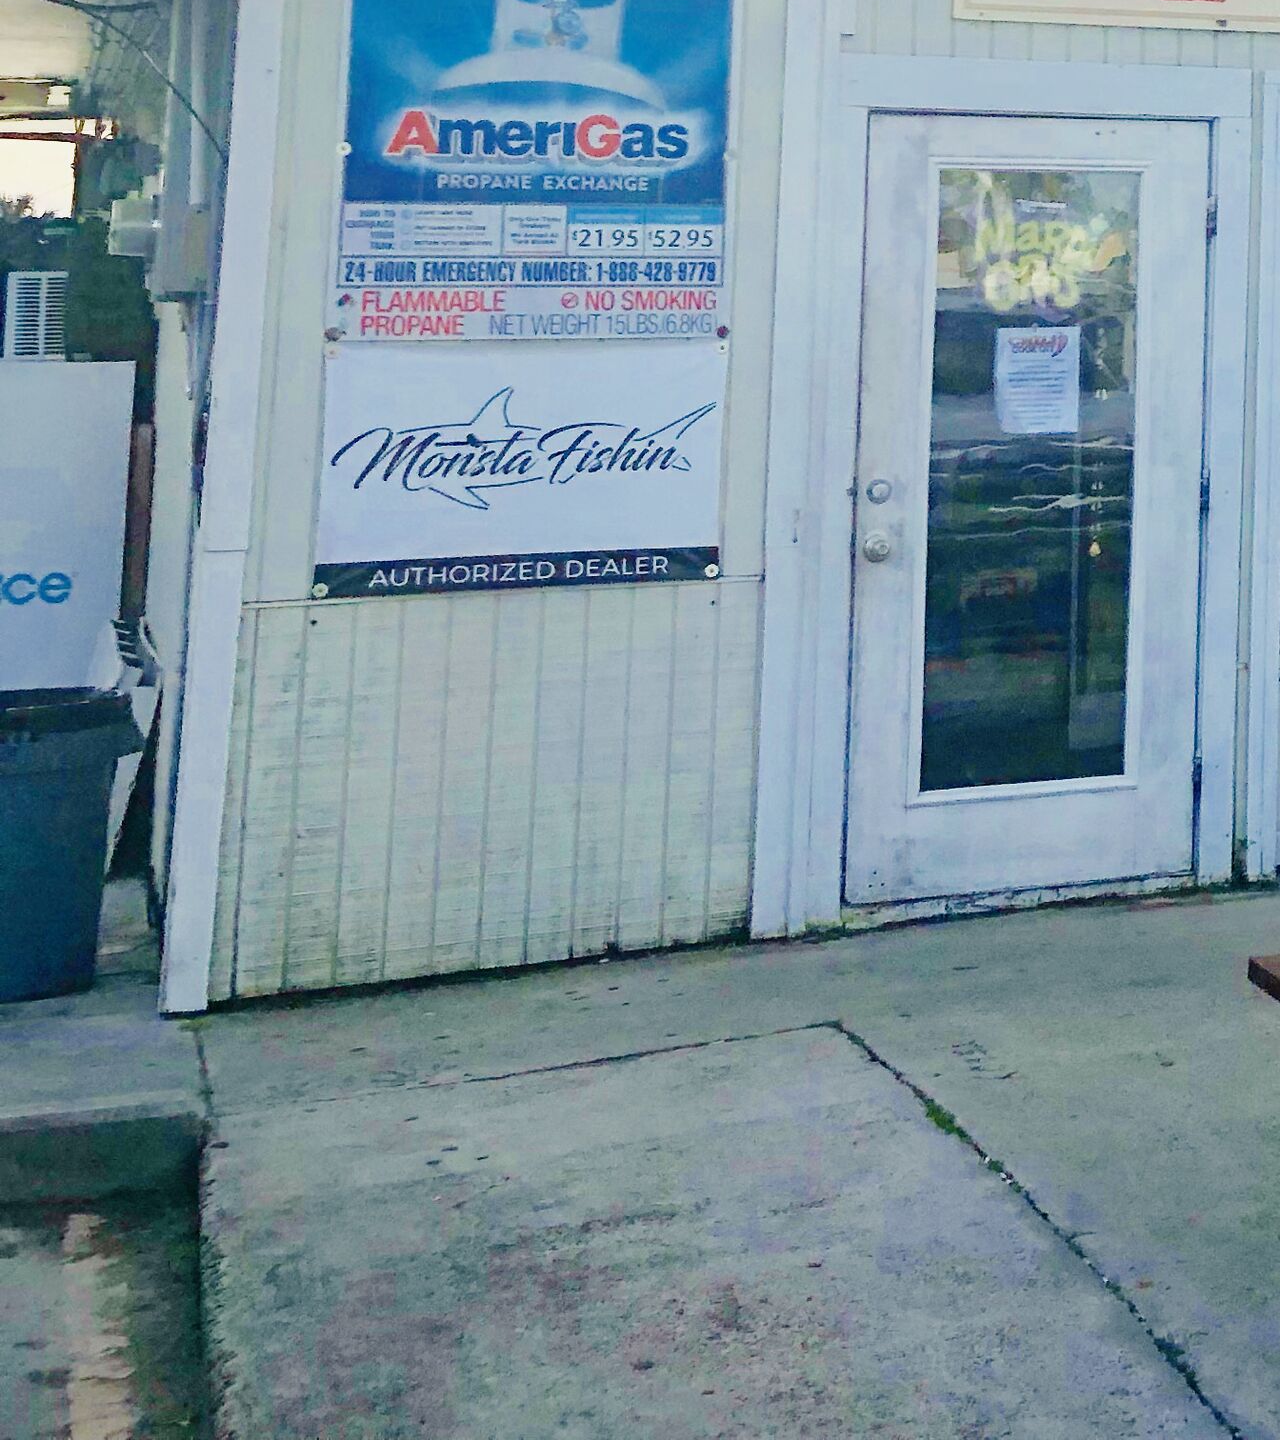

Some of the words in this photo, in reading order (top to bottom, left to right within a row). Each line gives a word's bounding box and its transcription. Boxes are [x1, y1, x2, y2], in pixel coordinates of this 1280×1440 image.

[386, 111, 689, 161] AmeriGas
[437, 174, 531, 190] PROPANE
[543, 175, 649, 192] EXCHANGE
[572, 229, 638, 247] $21.95
[648, 230, 713, 248] $52.95
[345, 261, 415, 282] 24-HOUR
[422, 262, 514, 282] EMERGENCY
[521, 262, 592, 282] NUMBER:
[362, 291, 506, 312] FLAMMABLE
[585, 291, 614, 311] NO
[621, 291, 717, 311] SMOKING
[361, 315, 464, 336] PROPANE
[488, 315, 525, 335] NET
[532, 314, 599, 335] WEIGHT
[331, 427, 536, 491] Monsta
[538, 423, 673, 484] Fishin
[369, 561, 557, 589] AUTHORIZED
[564, 556, 669, 578] DEALER
[0, 571, 73, 606] ce
